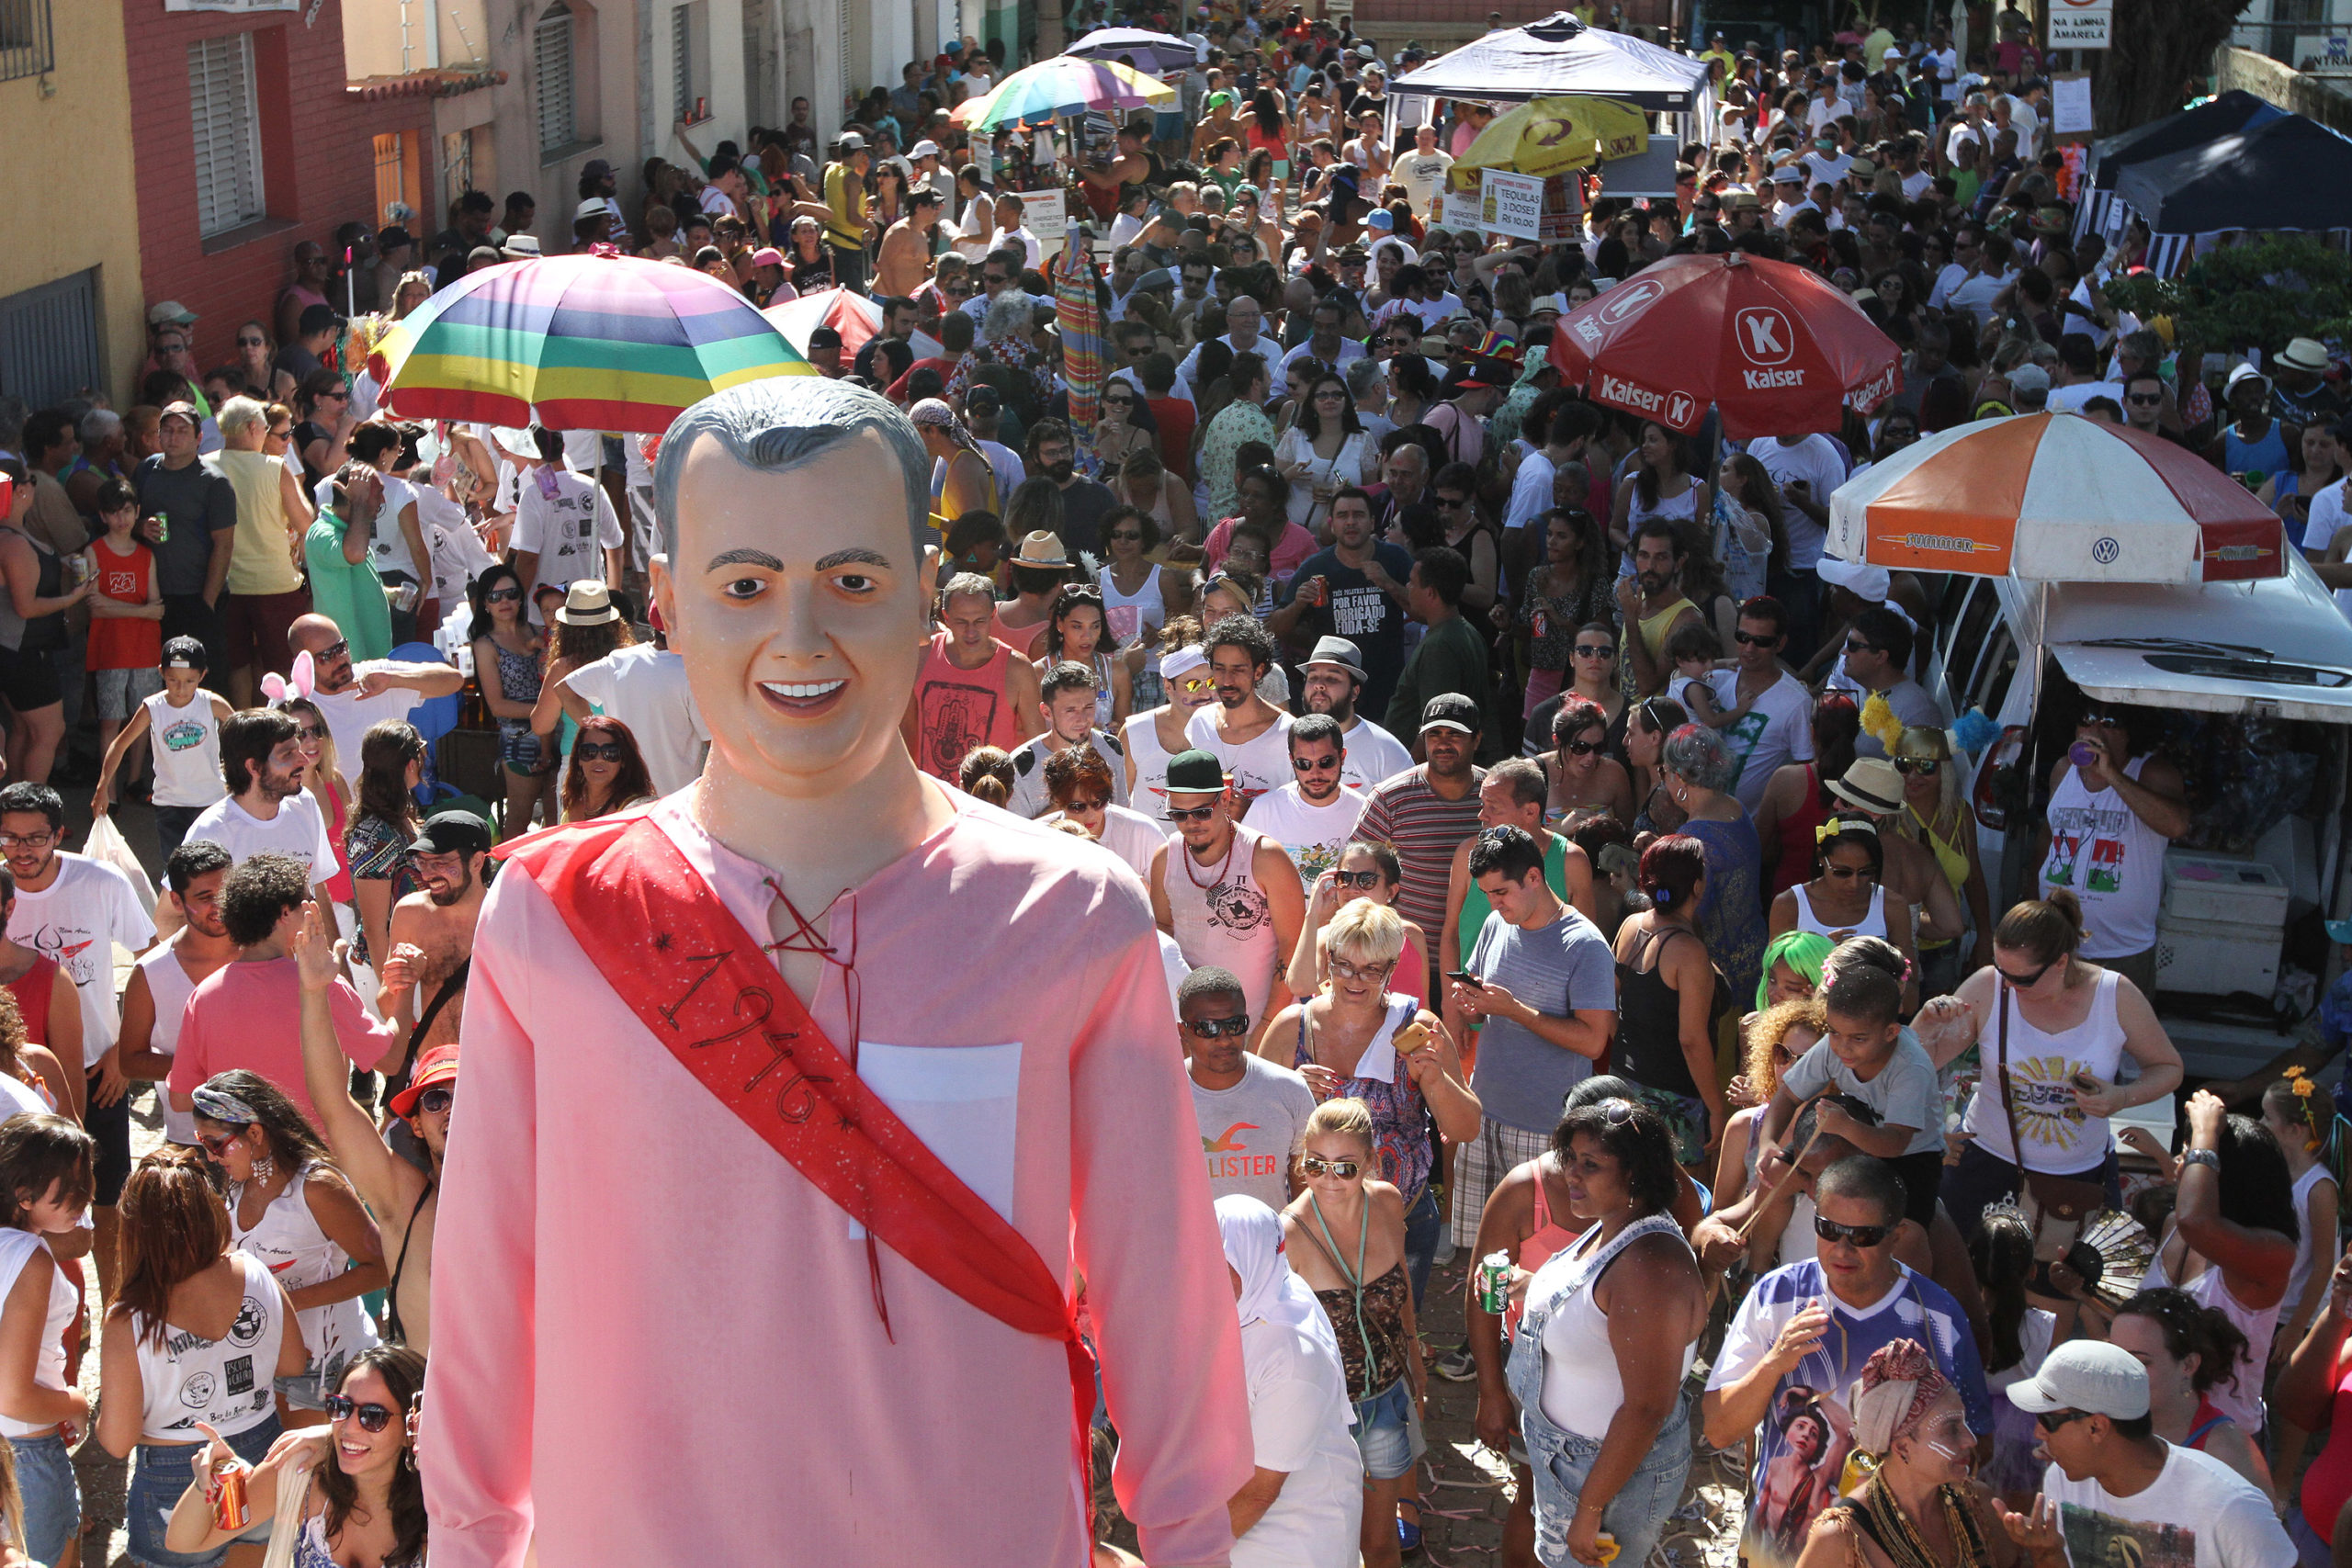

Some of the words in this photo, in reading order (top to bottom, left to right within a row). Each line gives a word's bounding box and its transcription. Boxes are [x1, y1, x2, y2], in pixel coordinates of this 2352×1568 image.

[2052, 17, 2067, 27] NA
[2073, 17, 2106, 27] LINHA
[1501, 188, 1540, 204] TEQUILAS
[1503, 202, 1508, 210] 3
[1509, 202, 1535, 215] DOSES
[1502, 213, 1512, 223] R$
[1574, 314, 1603, 343] Kaiser
[1742, 367, 1805, 389] Kaiser
[1600, 374, 1664, 412] Kaiser
[1851, 378, 1884, 412] Kaiser
[1905, 533, 1975, 553] SUMMER
[1333, 596, 1350, 609] POR
[1351, 593, 1381, 607] FAVOR
[1333, 604, 1385, 623] OBRIGADO
[1335, 618, 1380, 635] FODA-SE
